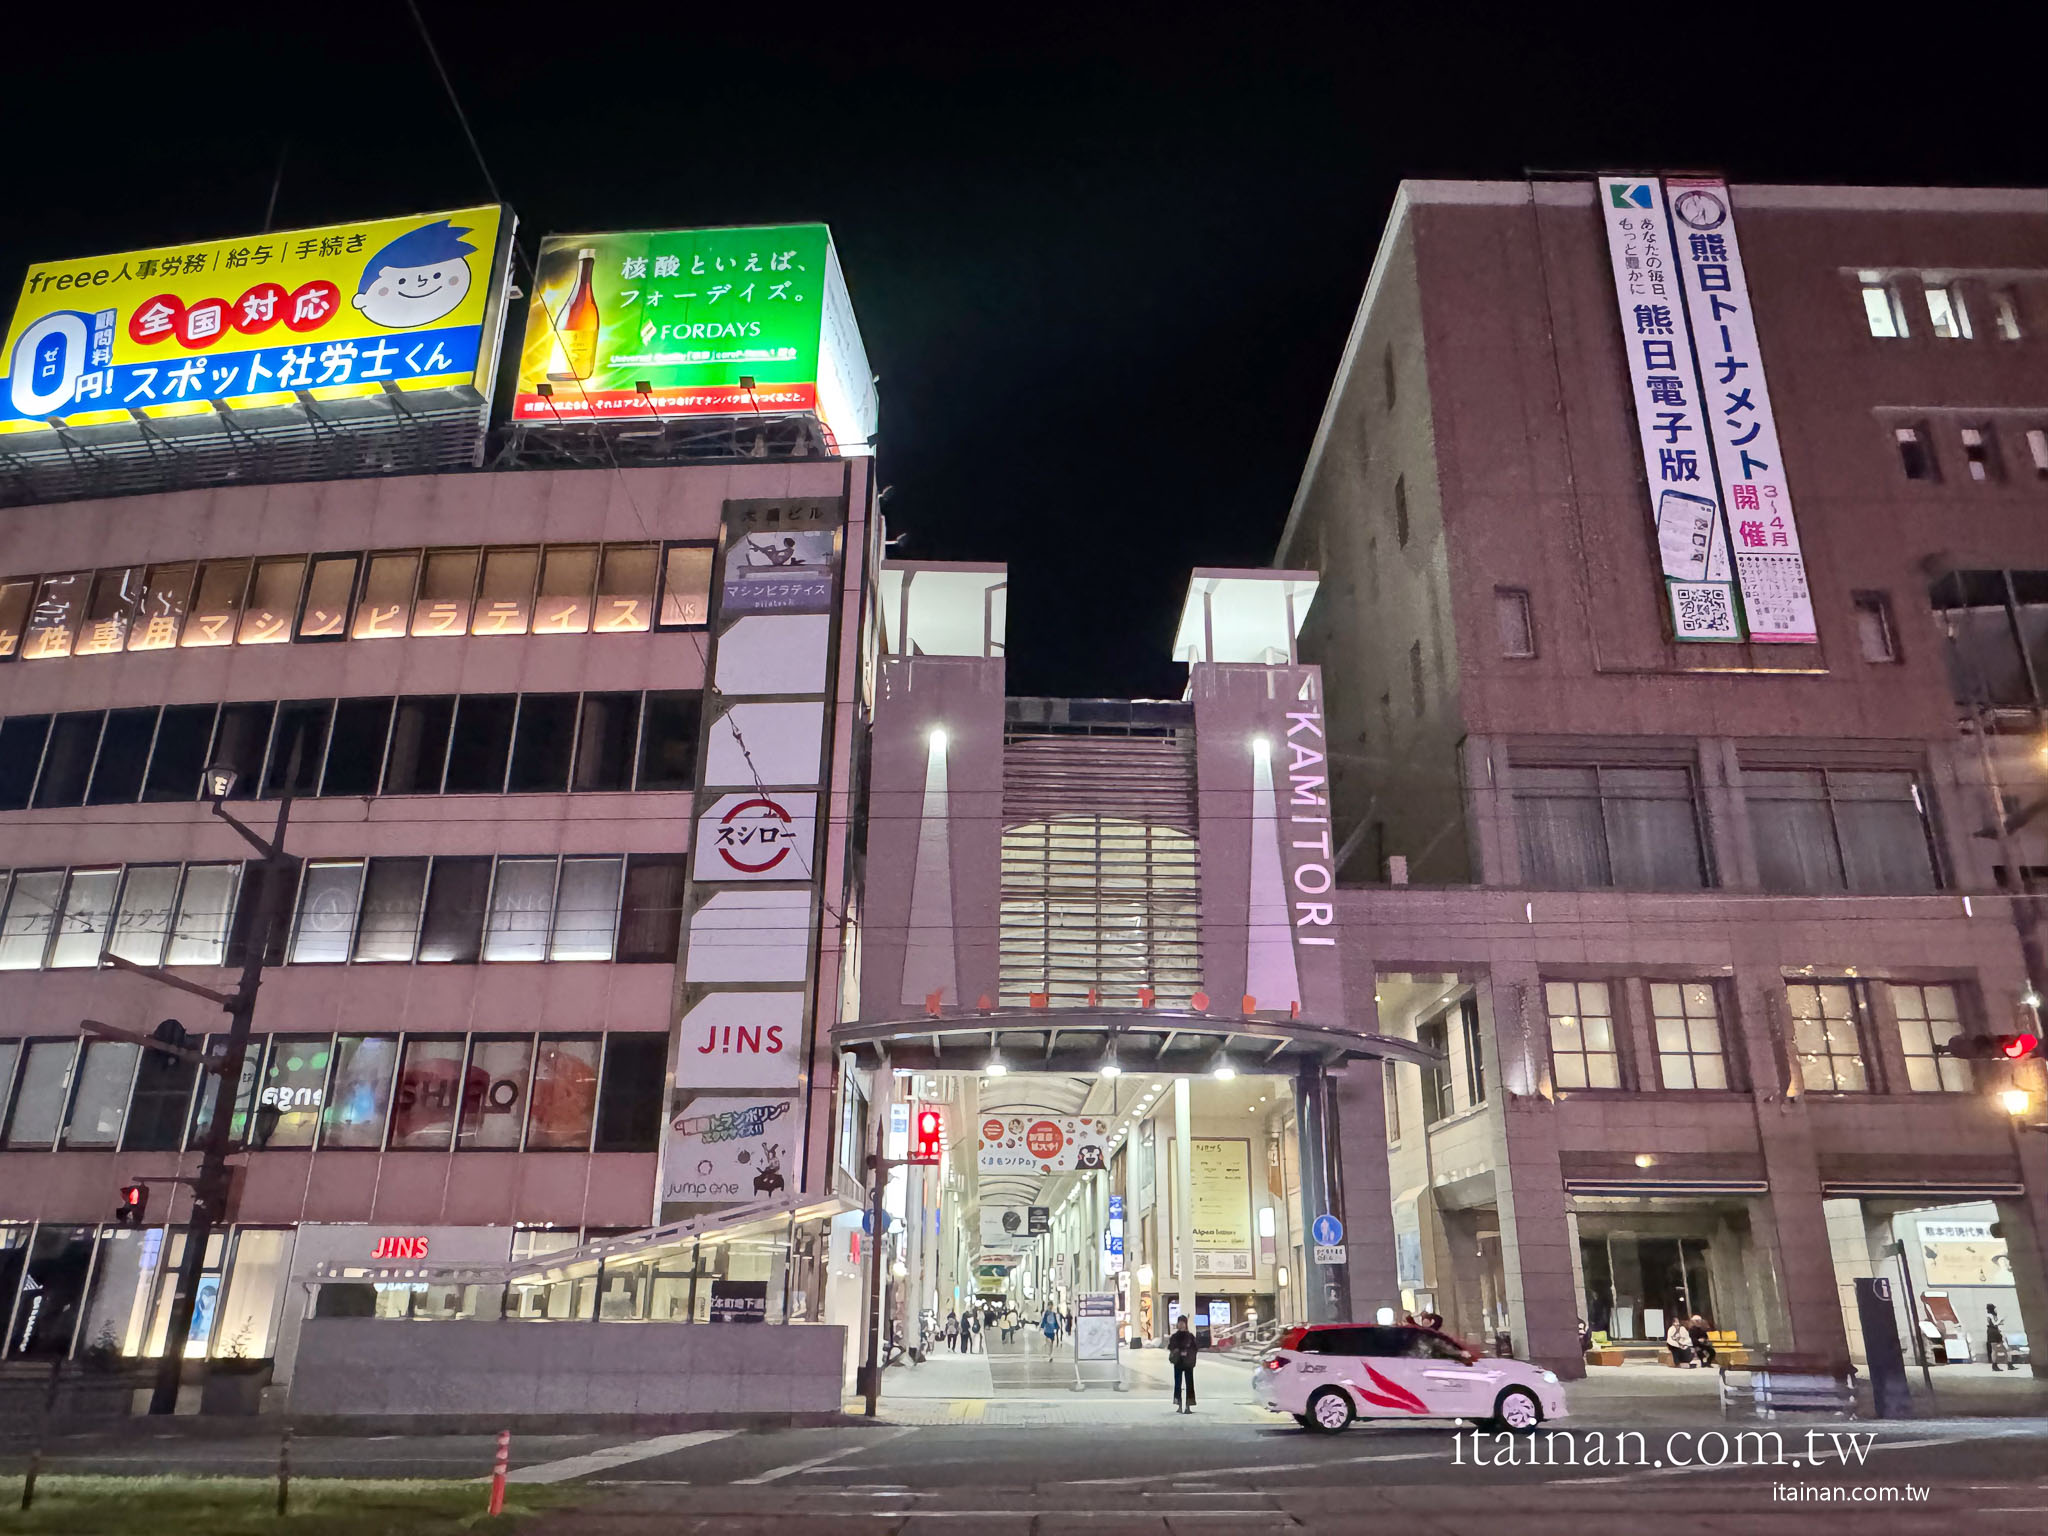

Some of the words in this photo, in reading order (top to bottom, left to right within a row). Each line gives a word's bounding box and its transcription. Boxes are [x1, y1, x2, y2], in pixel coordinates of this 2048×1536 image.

[621, 251, 807, 280] 核酸といえば、
[1640, 218, 1669, 301] あなたの毎日、
[138, 282, 331, 340] 全国対応
[619, 280, 804, 308] フォーデイズ。
[661, 321, 761, 340] FORDAYS
[1688, 233, 1769, 480] 熊日トーナメント
[123, 339, 453, 403] スポット社労士くん
[1633, 304, 1701, 482] 熊日電子版
[1733, 484, 1768, 547] 開催
[714, 820, 797, 847] スシロー
[1286, 712, 1336, 946] KAMITORI
[667, 1182, 707, 1197] jump
[709, 1182, 739, 1194] one
